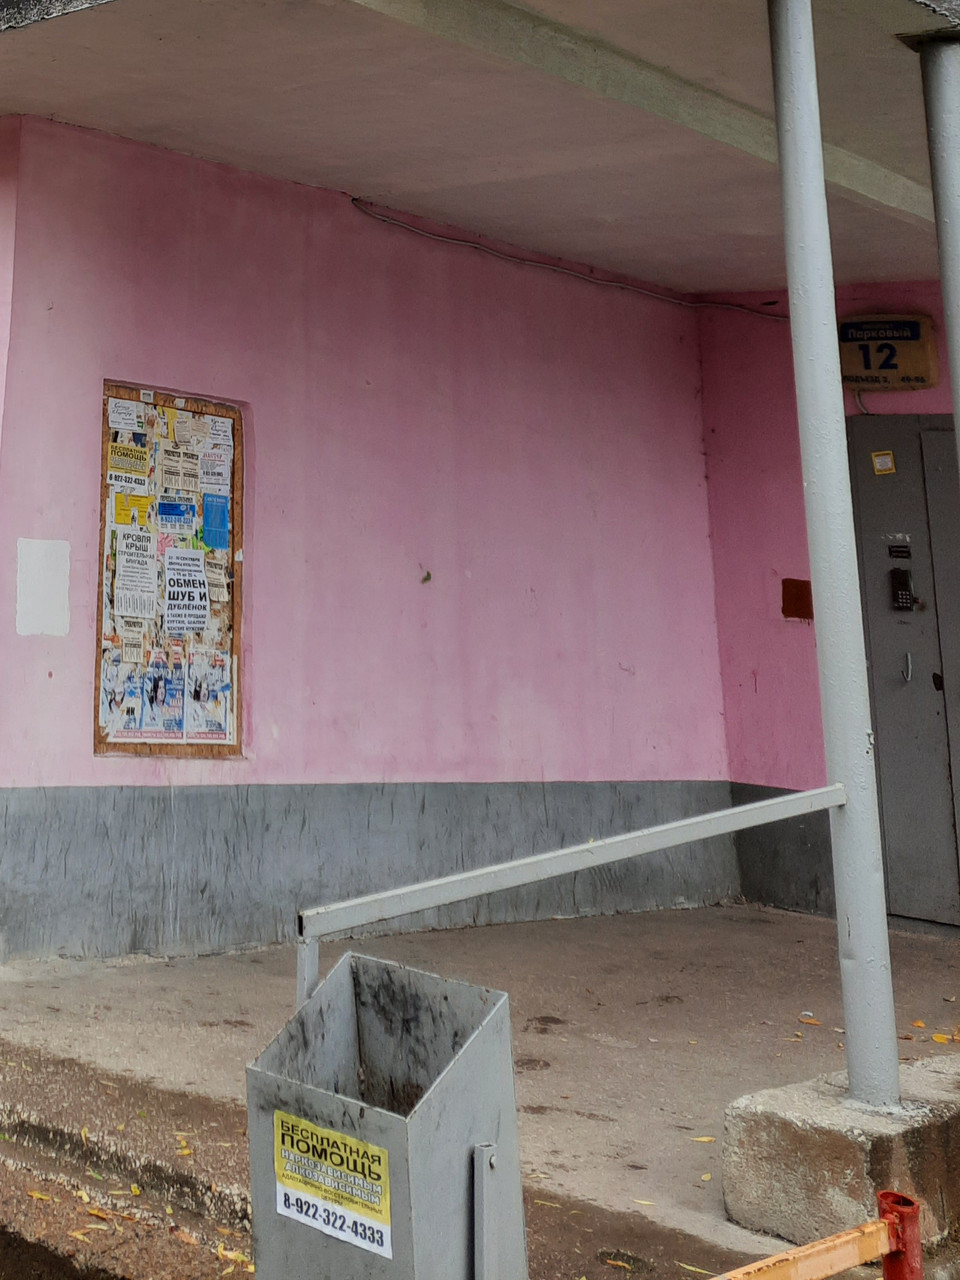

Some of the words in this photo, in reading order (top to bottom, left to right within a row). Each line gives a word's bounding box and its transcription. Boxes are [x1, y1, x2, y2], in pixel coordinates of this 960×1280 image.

[848, 327, 911, 339] Парковый
[859, 343, 898, 370] 12
[110, 450, 147, 462] ПОМОЩЬ
[111, 445, 147, 455] БЕСПЛАТНАЯ
[122, 533, 151, 544] КРОВЛЯ
[125, 542, 148, 552] КРЫШ
[118, 550, 155, 560] СТРОИТЕЛЬНАЯ
[125, 558, 148, 566] БРИГАДА
[168, 578, 207, 589] ОБМЕН
[168, 590, 195, 601] ШУБ
[199, 591, 207, 602] И
[167, 602, 207, 612] ДУБЛЁНОК
[280, 1120, 382, 1167] БЕСПЛАТНАЯ
[281, 1133, 382, 1181] ПОМОЩЬ
[281, 1149, 383, 1196] НАРКОЗАВИСИМЫМ
[284, 1162, 381, 1206] АЛКОЗАВИСИМЫМ
[283, 1192, 384, 1247] 8-922-322-4333
